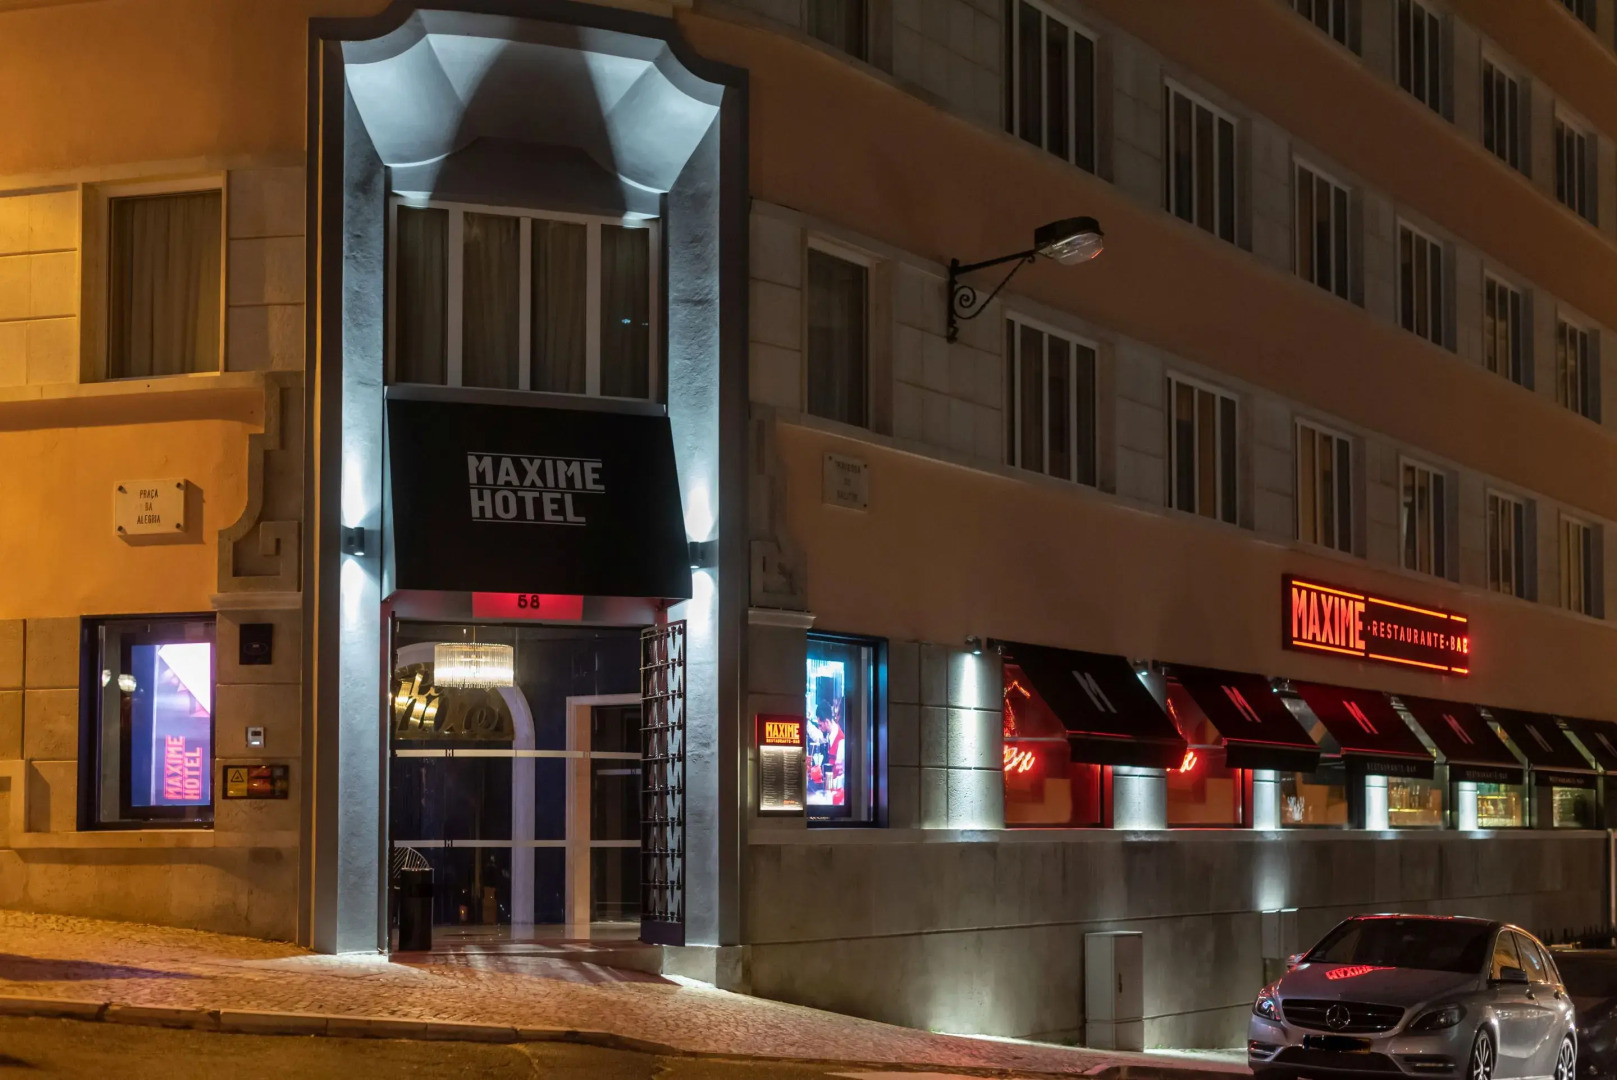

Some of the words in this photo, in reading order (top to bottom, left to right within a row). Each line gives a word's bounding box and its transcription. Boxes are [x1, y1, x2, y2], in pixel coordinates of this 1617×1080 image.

[467, 454, 606, 490] MAXIME
[139, 488, 159, 500] PRAÇA
[144, 501, 153, 512] DA
[469, 488, 587, 523] HOTEL
[136, 514, 161, 525] ALEGRIA
[517, 593, 541, 610] 58
[1291, 587, 1366, 650] MAXIME
[1372, 620, 1445, 649] RESTAURANTE
[1449, 635, 1469, 654] BAR
[765, 722, 800, 739] MAXIME
[165, 735, 184, 800] MAXIME
[184, 747, 202, 800] HOTEL
